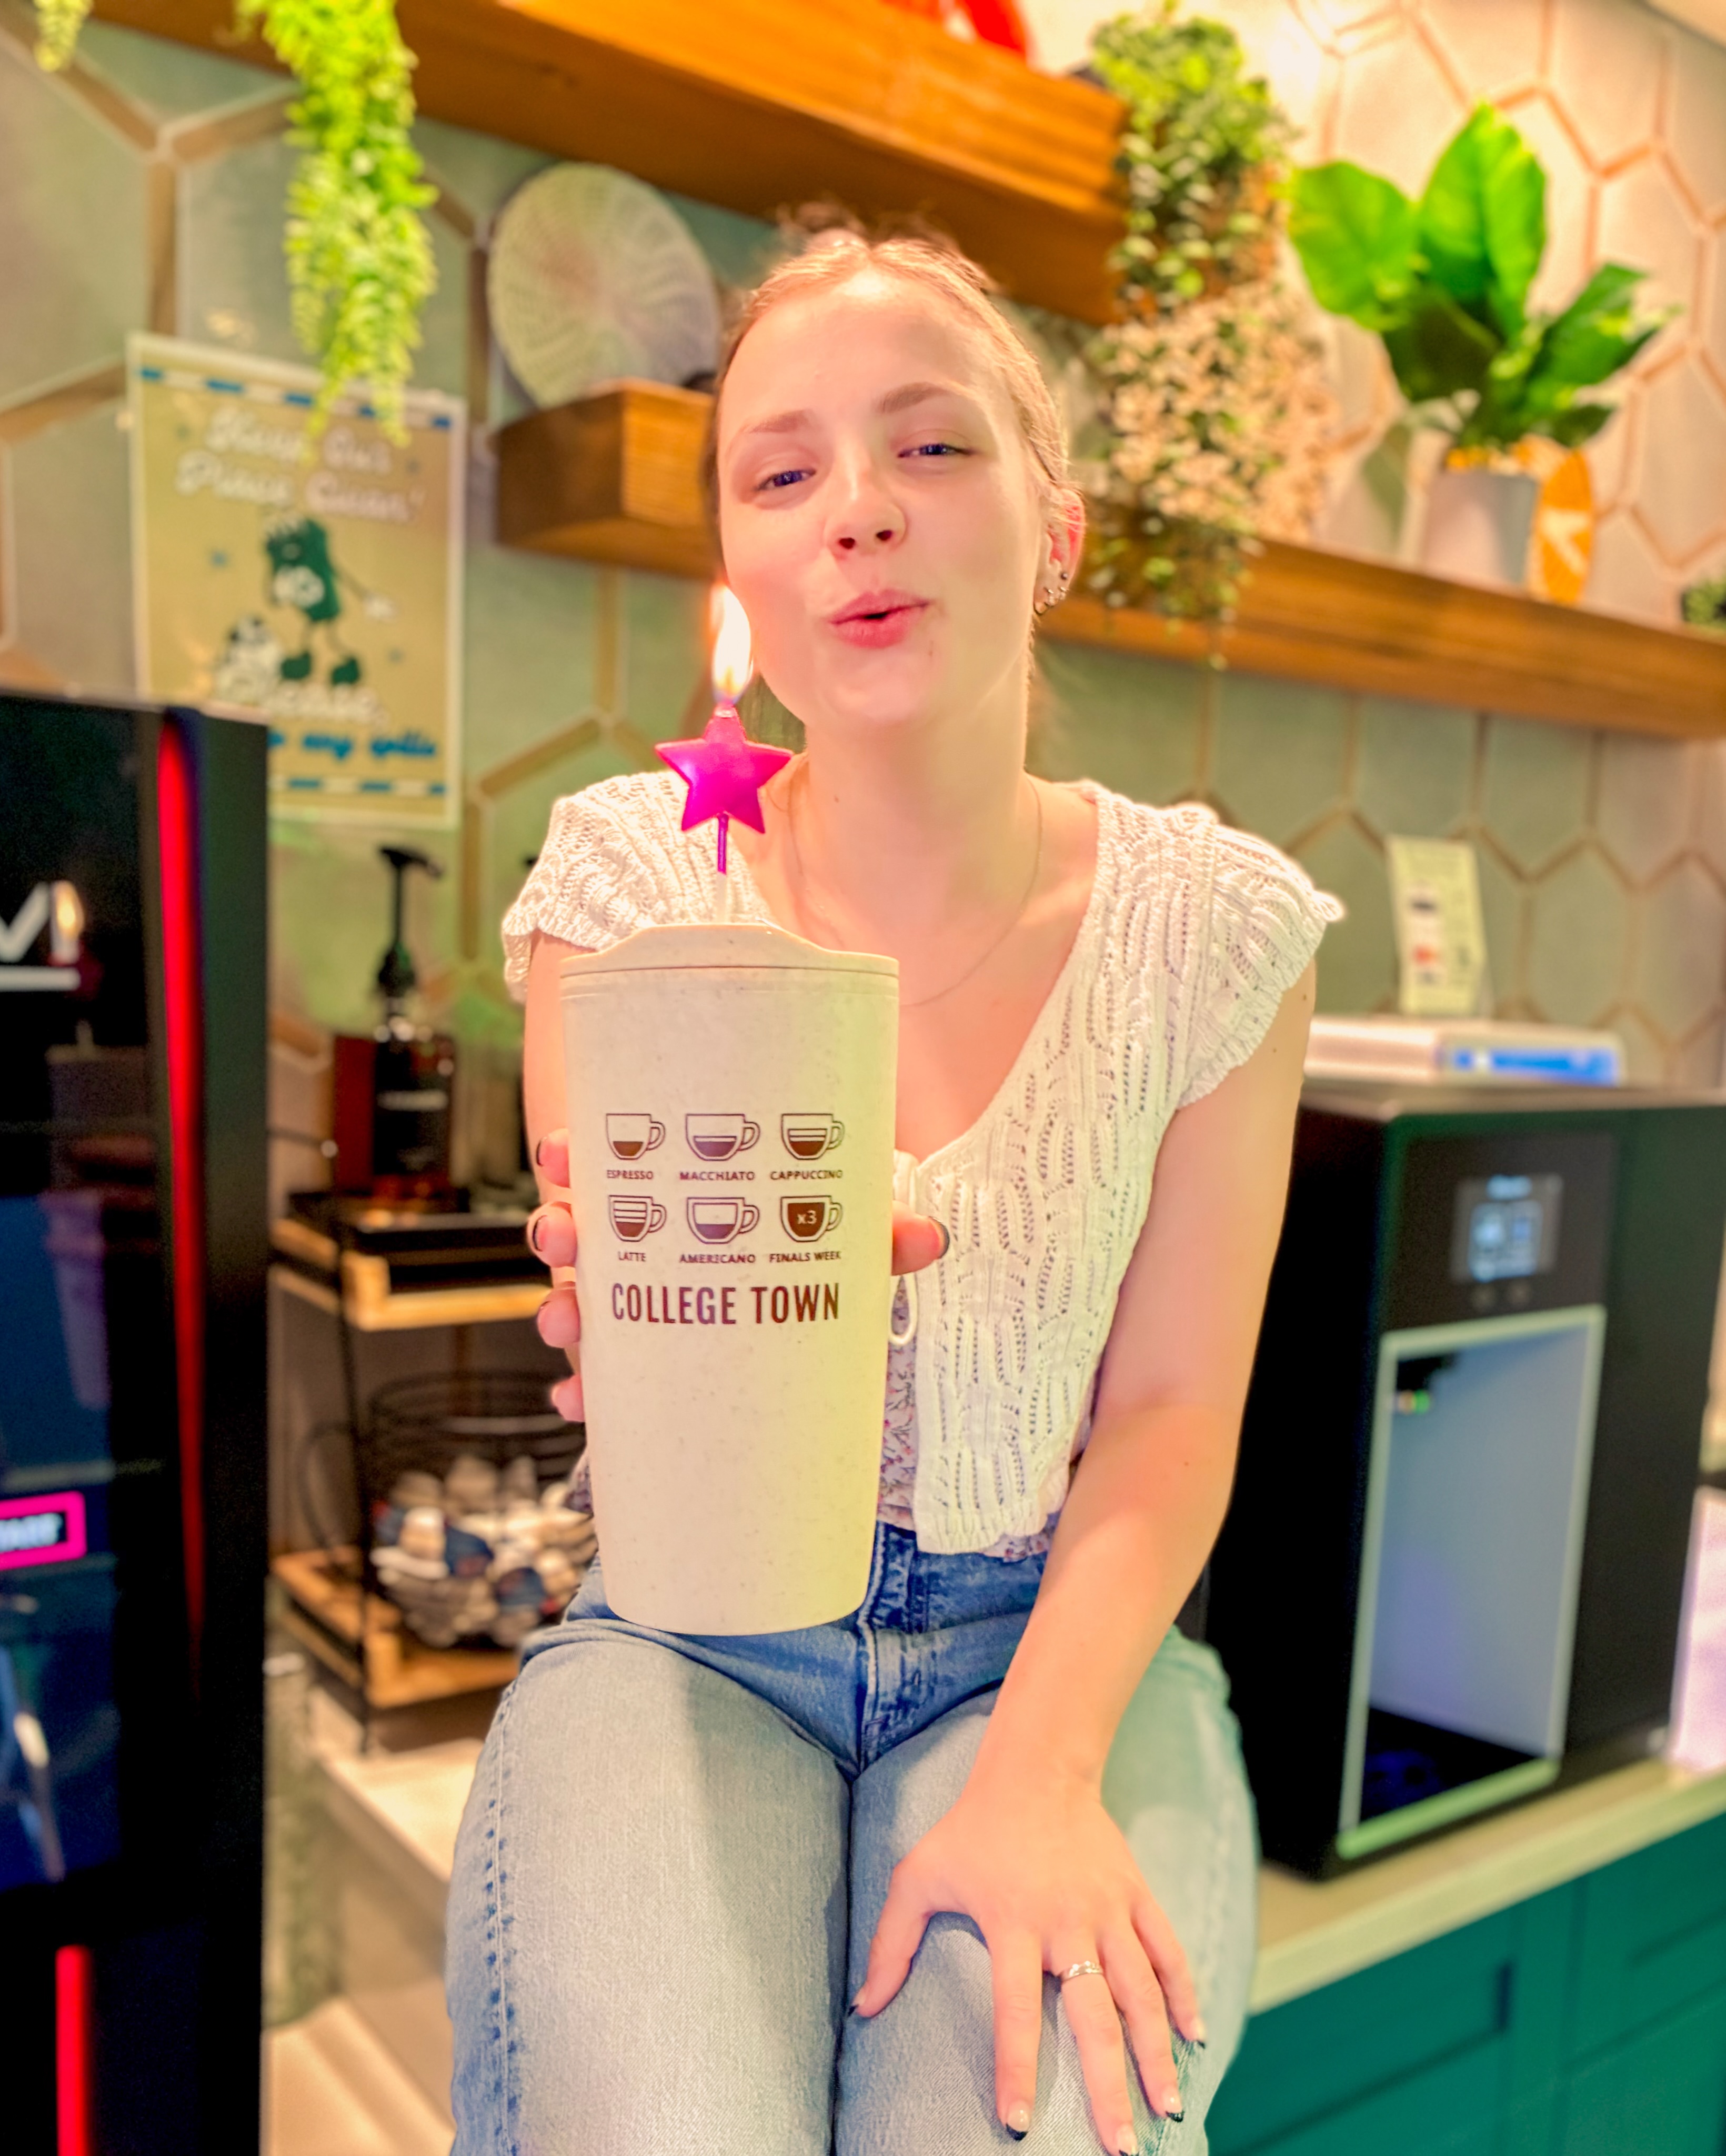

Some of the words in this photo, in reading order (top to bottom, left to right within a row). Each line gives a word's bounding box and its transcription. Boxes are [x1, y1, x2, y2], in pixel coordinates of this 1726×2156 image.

[607, 1170, 654, 1180] ESPRESSO
[680, 1171, 755, 1181] MACCHIATO
[770, 1170, 843, 1180] CAPPUCCINO
[797, 1210, 817, 1225] x3
[618, 1251, 646, 1262] LATTE
[680, 1254, 756, 1264] AMERICANO
[769, 1252, 811, 1263] FINALS
[813, 1251, 841, 1261] WEEK
[611, 1283, 737, 1325] COLLEGE
[750, 1282, 839, 1324] TOWN
